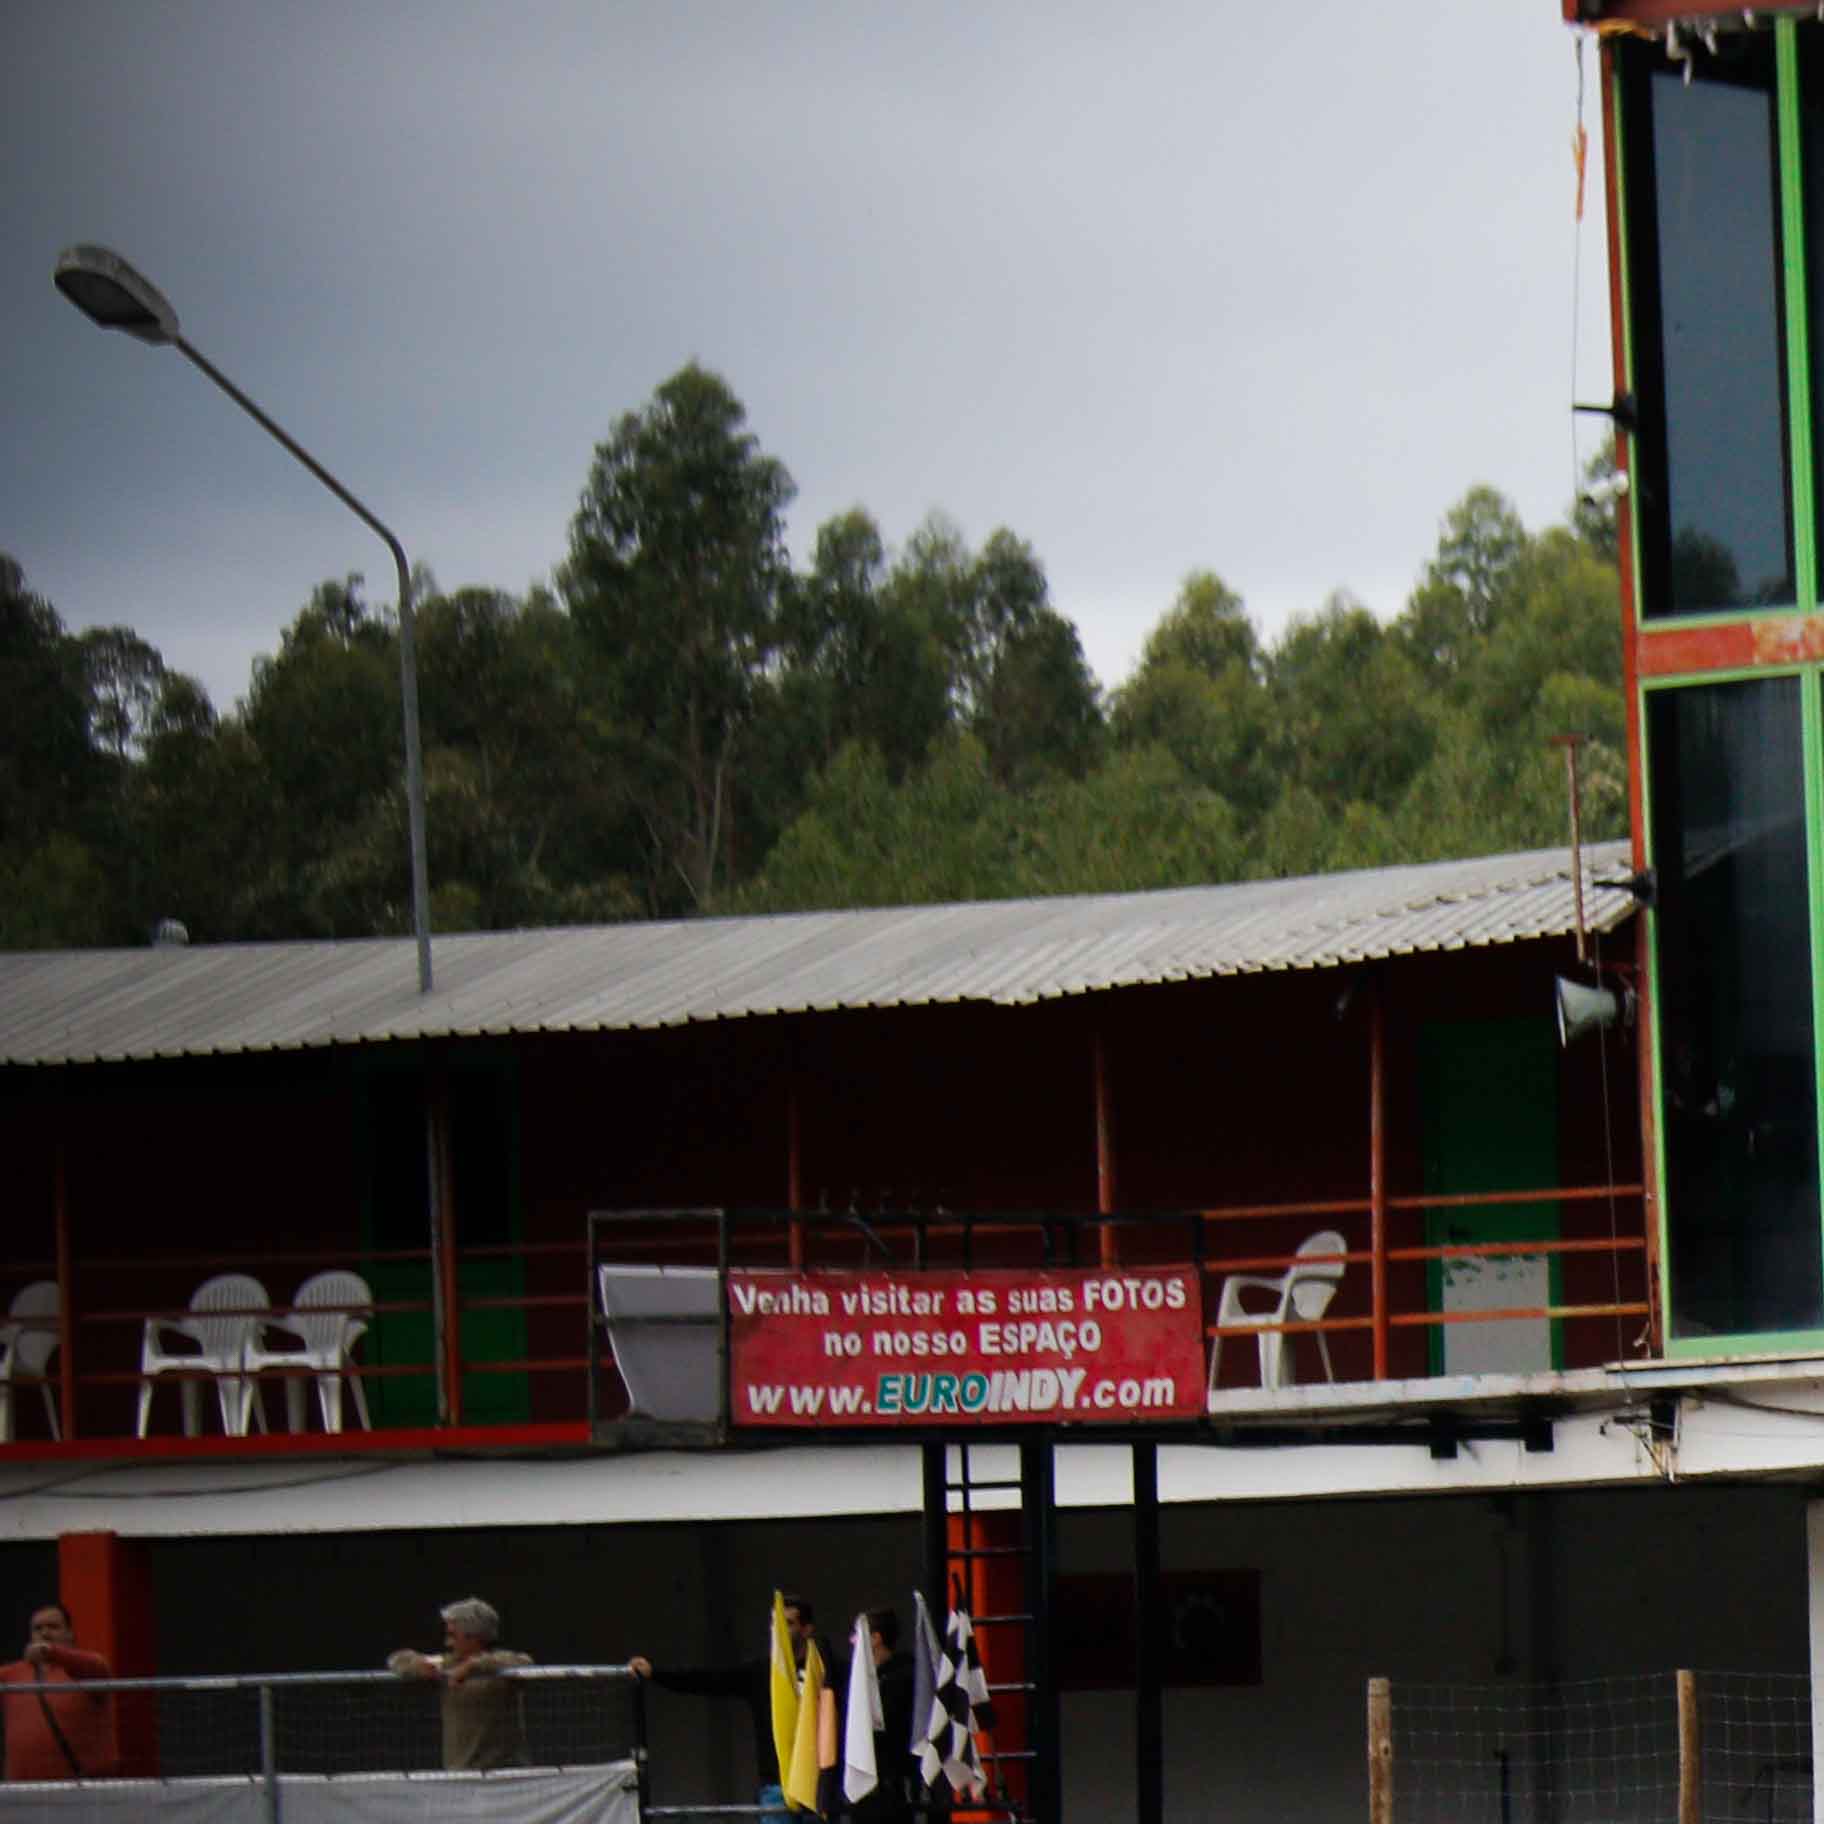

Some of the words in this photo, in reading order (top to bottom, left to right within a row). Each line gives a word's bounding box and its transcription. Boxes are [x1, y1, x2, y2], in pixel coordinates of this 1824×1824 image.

[733, 1283, 830, 1315] Venha
[841, 1282, 944, 1315] visitar
[955, 1290, 997, 1315] as
[1008, 1288, 1074, 1314] suas
[1083, 1278, 1186, 1311] FOTOS
[823, 1330, 862, 1356] no
[873, 1328, 967, 1356] nosso
[979, 1320, 1102, 1360] ESPAÇO
[747, 1367, 1175, 1415] www.EUROINDY.com
